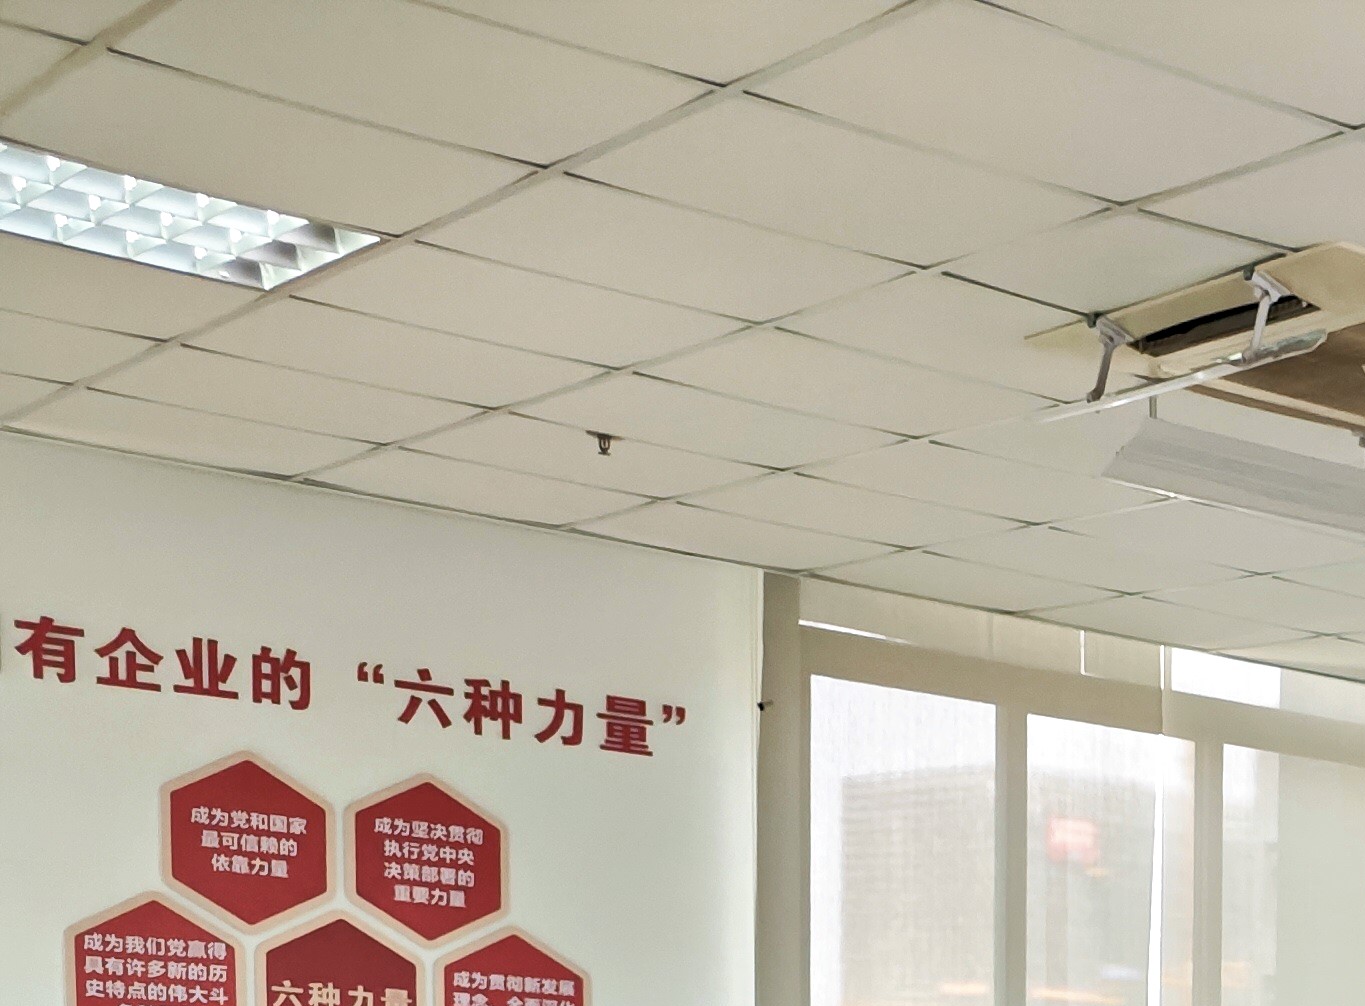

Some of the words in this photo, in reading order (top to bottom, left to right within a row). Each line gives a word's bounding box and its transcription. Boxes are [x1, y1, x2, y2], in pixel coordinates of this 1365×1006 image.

[190, 806, 307, 835] 成为党和国家
[374, 817, 483, 845] 成为坚决贯彻
[201, 829, 298, 856] 最可信赖的
[384, 839, 475, 865] 执行党中央
[211, 853, 289, 878] 依靠力量
[384, 861, 475, 887] 决策部署的
[394, 884, 466, 908] 重要力量
[83, 932, 227, 960] 成为我们党赢得
[84, 955, 228, 982] 具有许多新的历
[85, 978, 229, 1005] 史特点的伟大斗
[453, 970, 575, 996] 成为贯彻新发展
